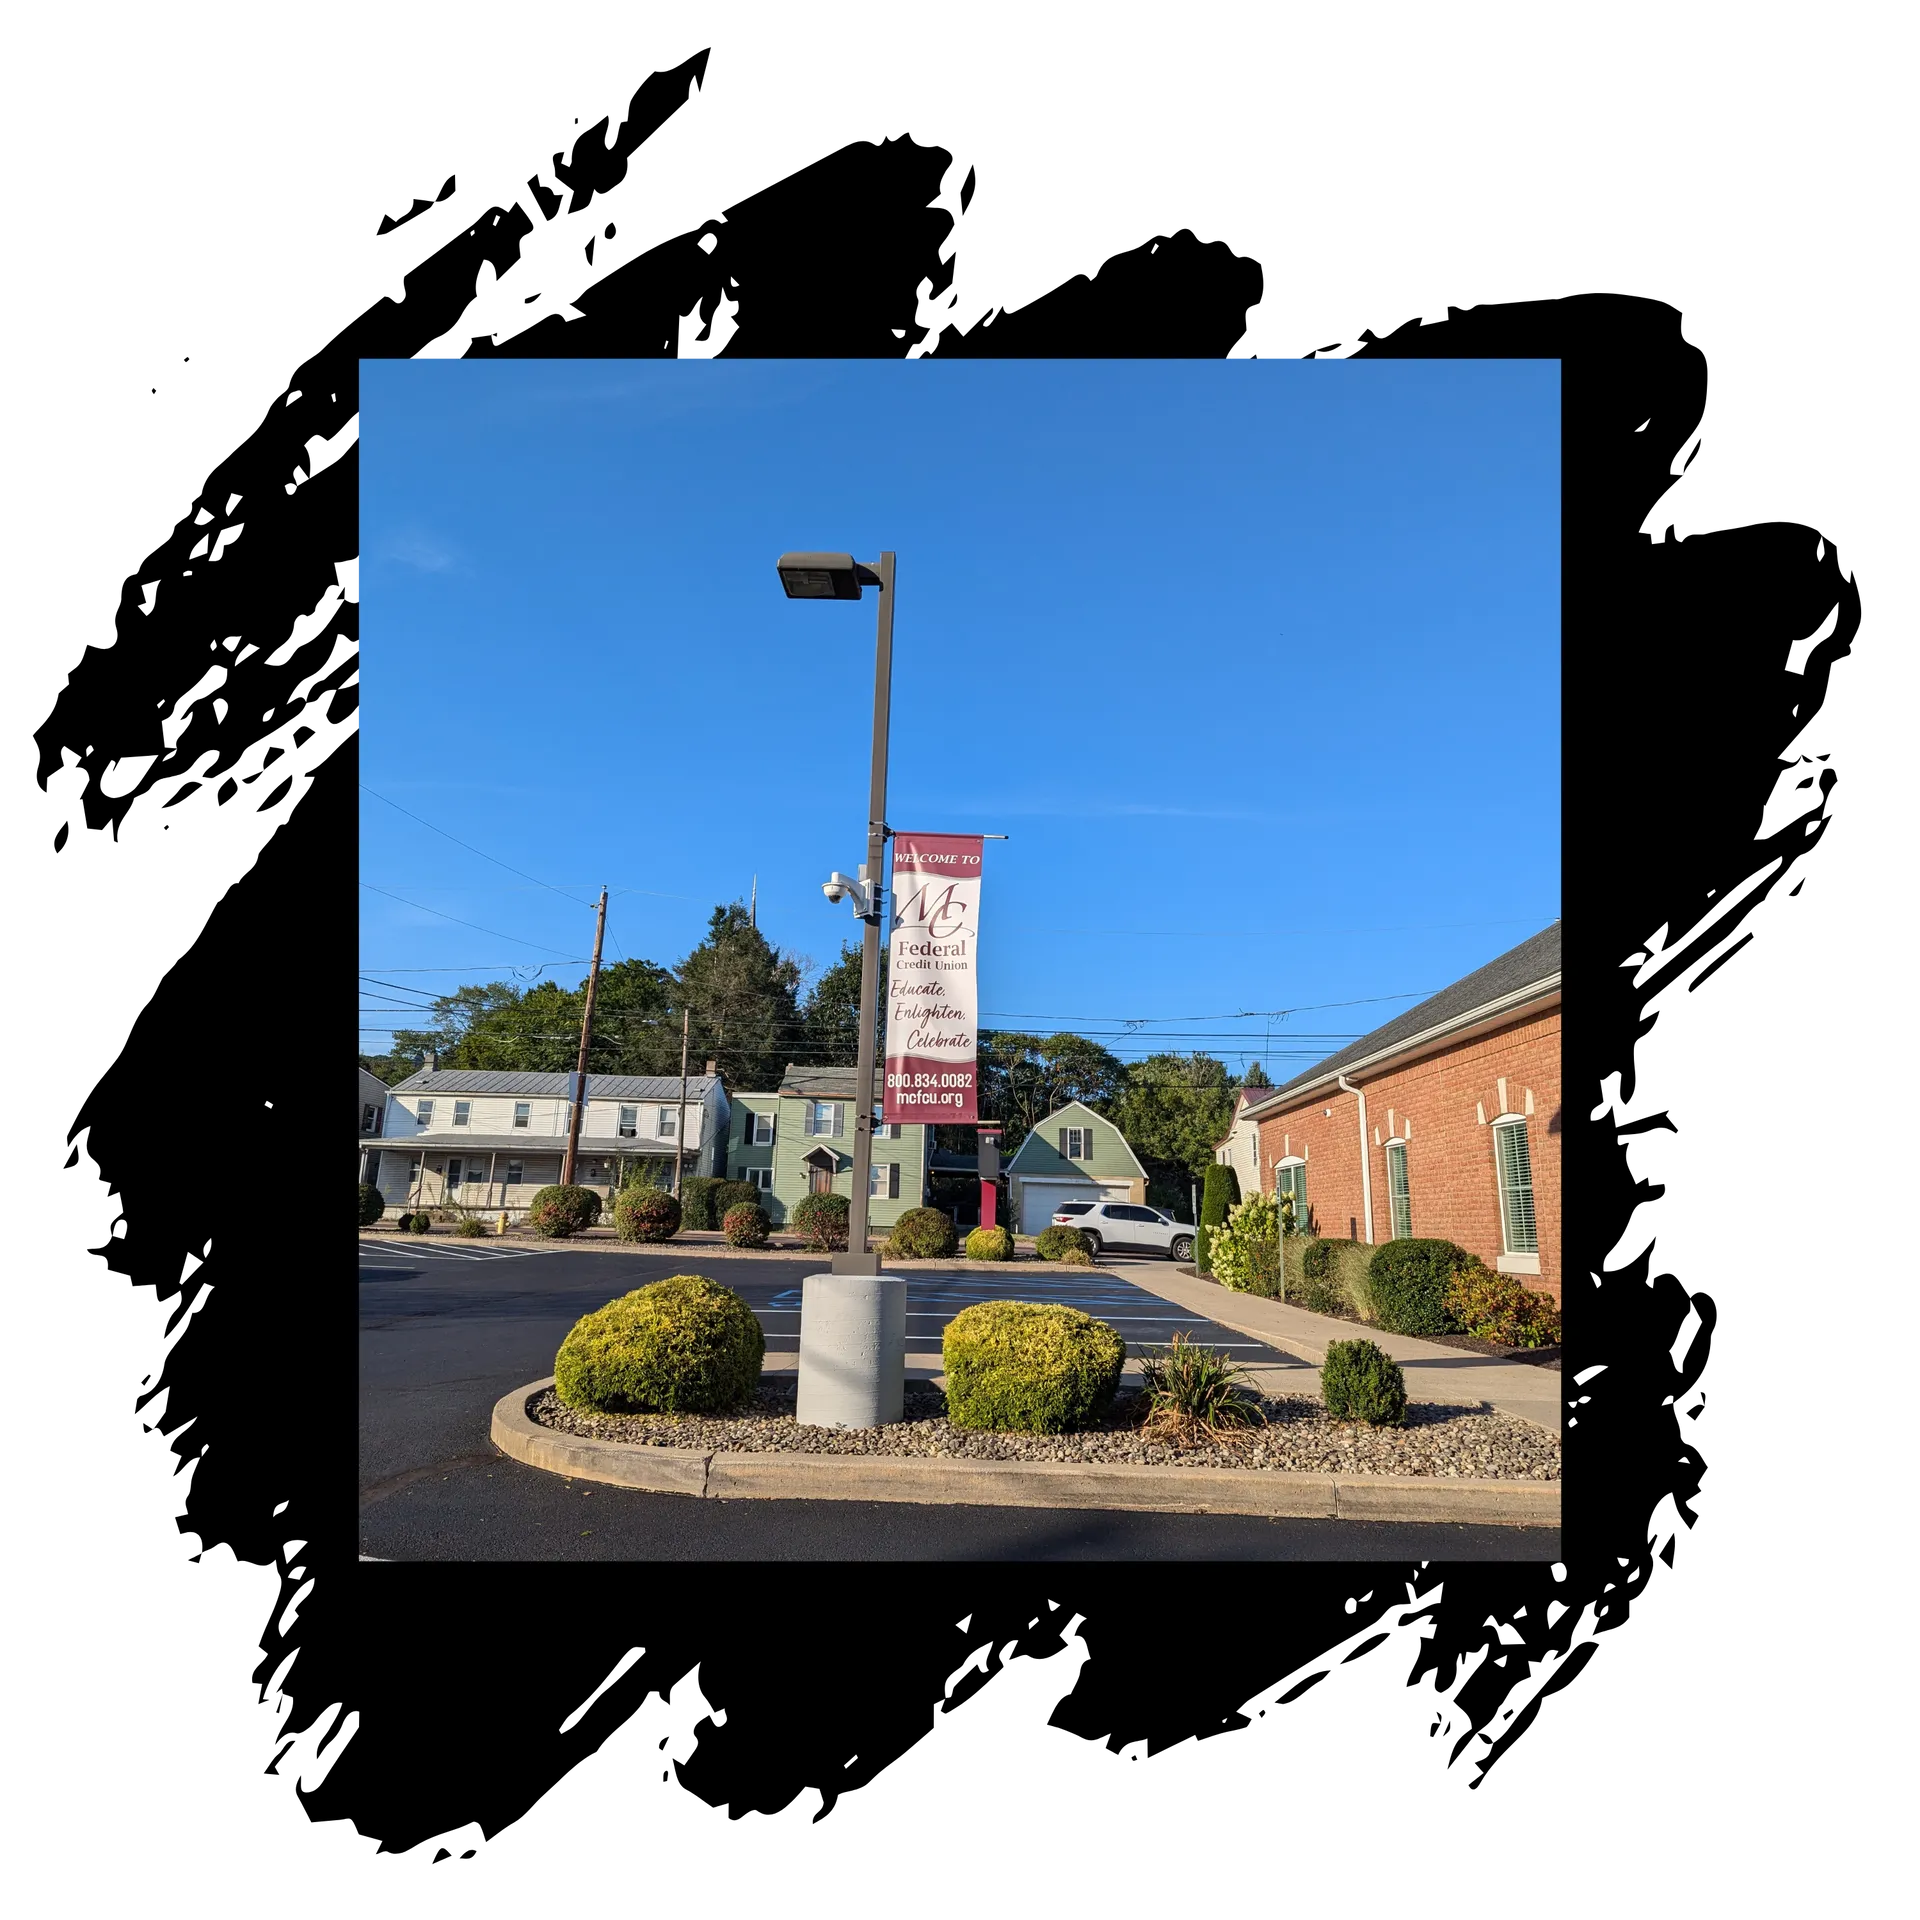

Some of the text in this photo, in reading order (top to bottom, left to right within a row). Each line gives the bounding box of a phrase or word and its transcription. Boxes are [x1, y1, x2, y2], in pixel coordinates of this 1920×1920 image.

[895, 853, 981, 865] WELCOME TO
[898, 940, 967, 957] Federal
[896, 960, 968, 971] Credit Union
[906, 1029, 973, 1050] Celebrate
[887, 1073, 973, 1088] 800.834.0082
[896, 1089, 963, 1108] mcfcu.org
